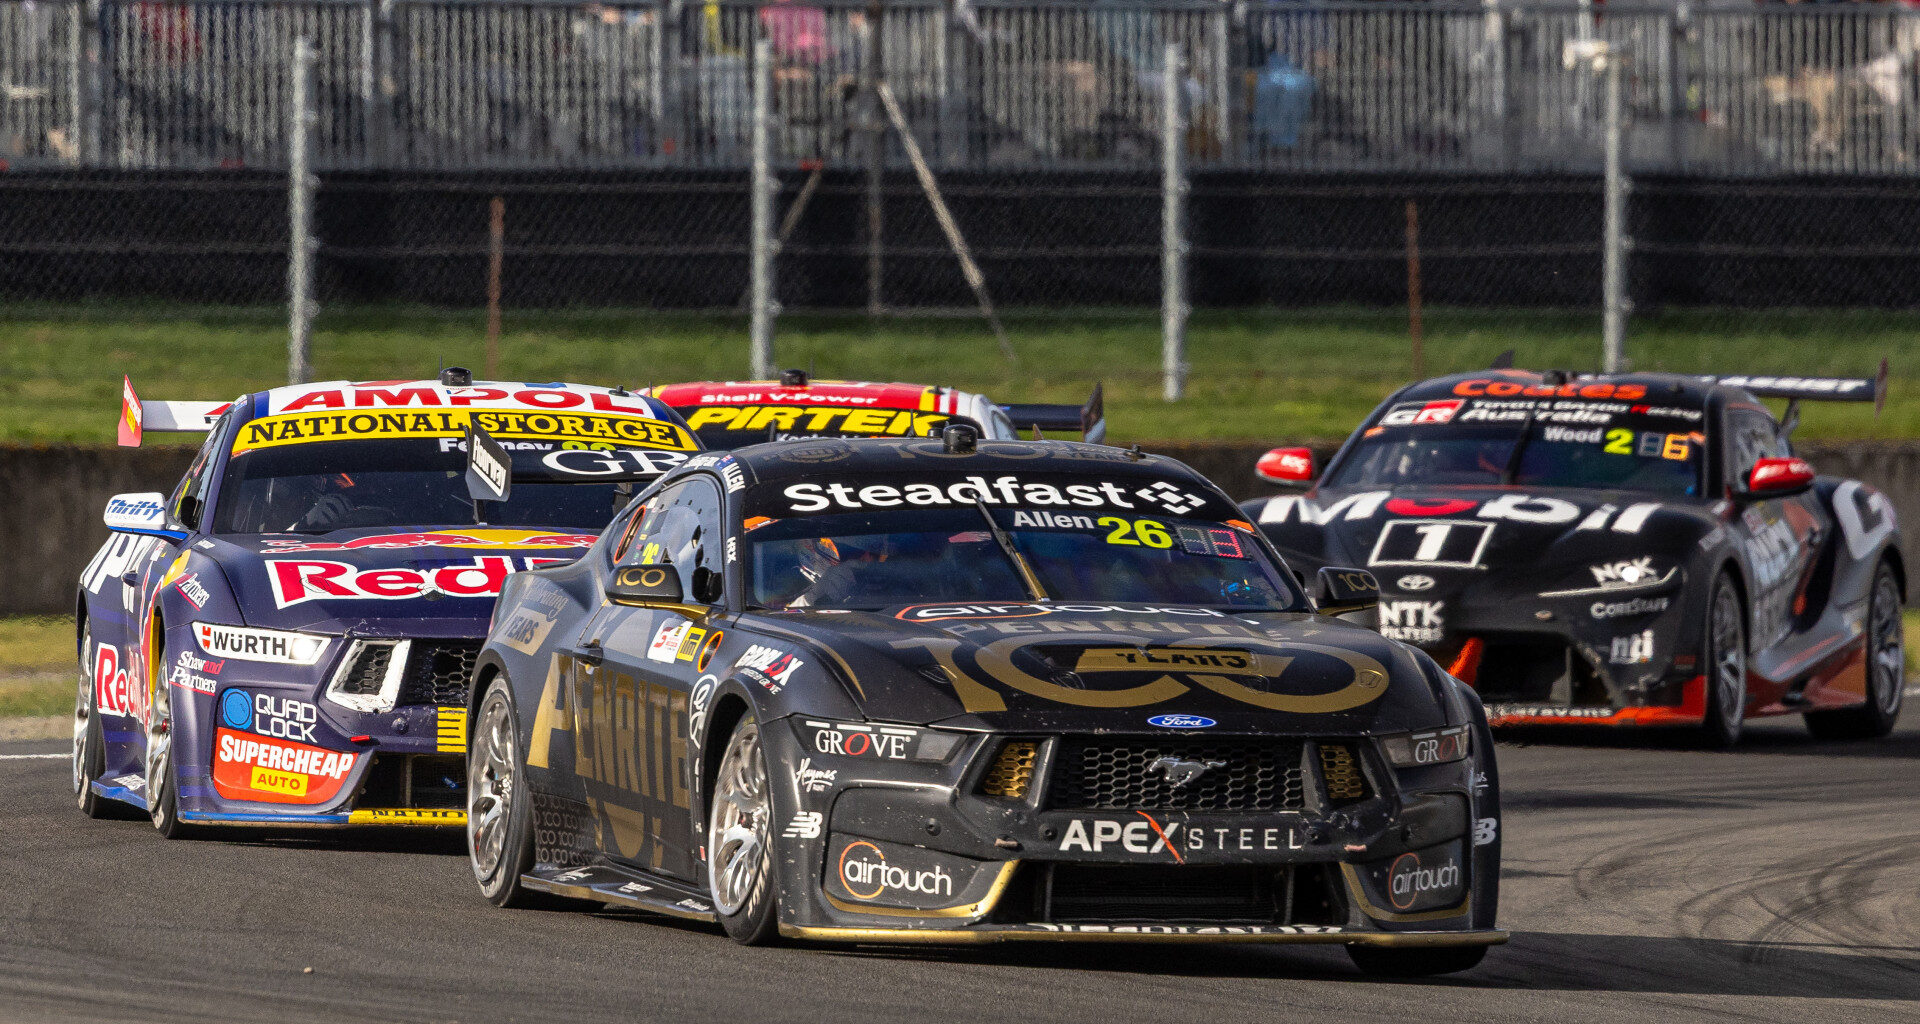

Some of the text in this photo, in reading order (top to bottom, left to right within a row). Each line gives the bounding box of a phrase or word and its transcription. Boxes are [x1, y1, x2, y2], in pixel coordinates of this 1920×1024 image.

[280, 388, 644, 414] AMPOL
[700, 393, 878, 404] Shell V-Power
[1453, 379, 1648, 400] Coates
[687, 406, 948, 436] PIRTEK
[1382, 402, 1462, 426] GR
[1459, 407, 1612, 424] Ausralia
[247, 412, 674, 445] NATIONAL STORAGE
[1544, 426, 1602, 444] Wood
[1603, 427, 1635, 455] 2
[439, 438, 553, 452] Feney
[721, 462, 746, 494] ALLEN
[784, 476, 1135, 512] Steadfast
[107, 499, 165, 522] Thrifty
[1259, 490, 1663, 534] Mobil
[1013, 510, 1174, 550] Allen 26
[1415, 524, 1452, 561] 1
[264, 555, 517, 609] Red
[615, 568, 666, 588] 100
[1338, 573, 1379, 592] 100
[1379, 601, 1444, 626] NTK
[213, 630, 286, 656] WÜRTH
[169, 666, 217, 693] Partners
[888, 633, 1390, 713] 100
[255, 693, 317, 725] QUAD
[1160, 715, 1203, 727] Ford
[255, 714, 318, 743] LOCK
[219, 735, 354, 780] SUPERCHEAP
[815, 729, 907, 759] GROVE
[256, 773, 301, 790] AUTO
[1059, 811, 1302, 864] APEX STEEL
[844, 857, 952, 896] airtouch
[1392, 858, 1459, 896] airtouch
